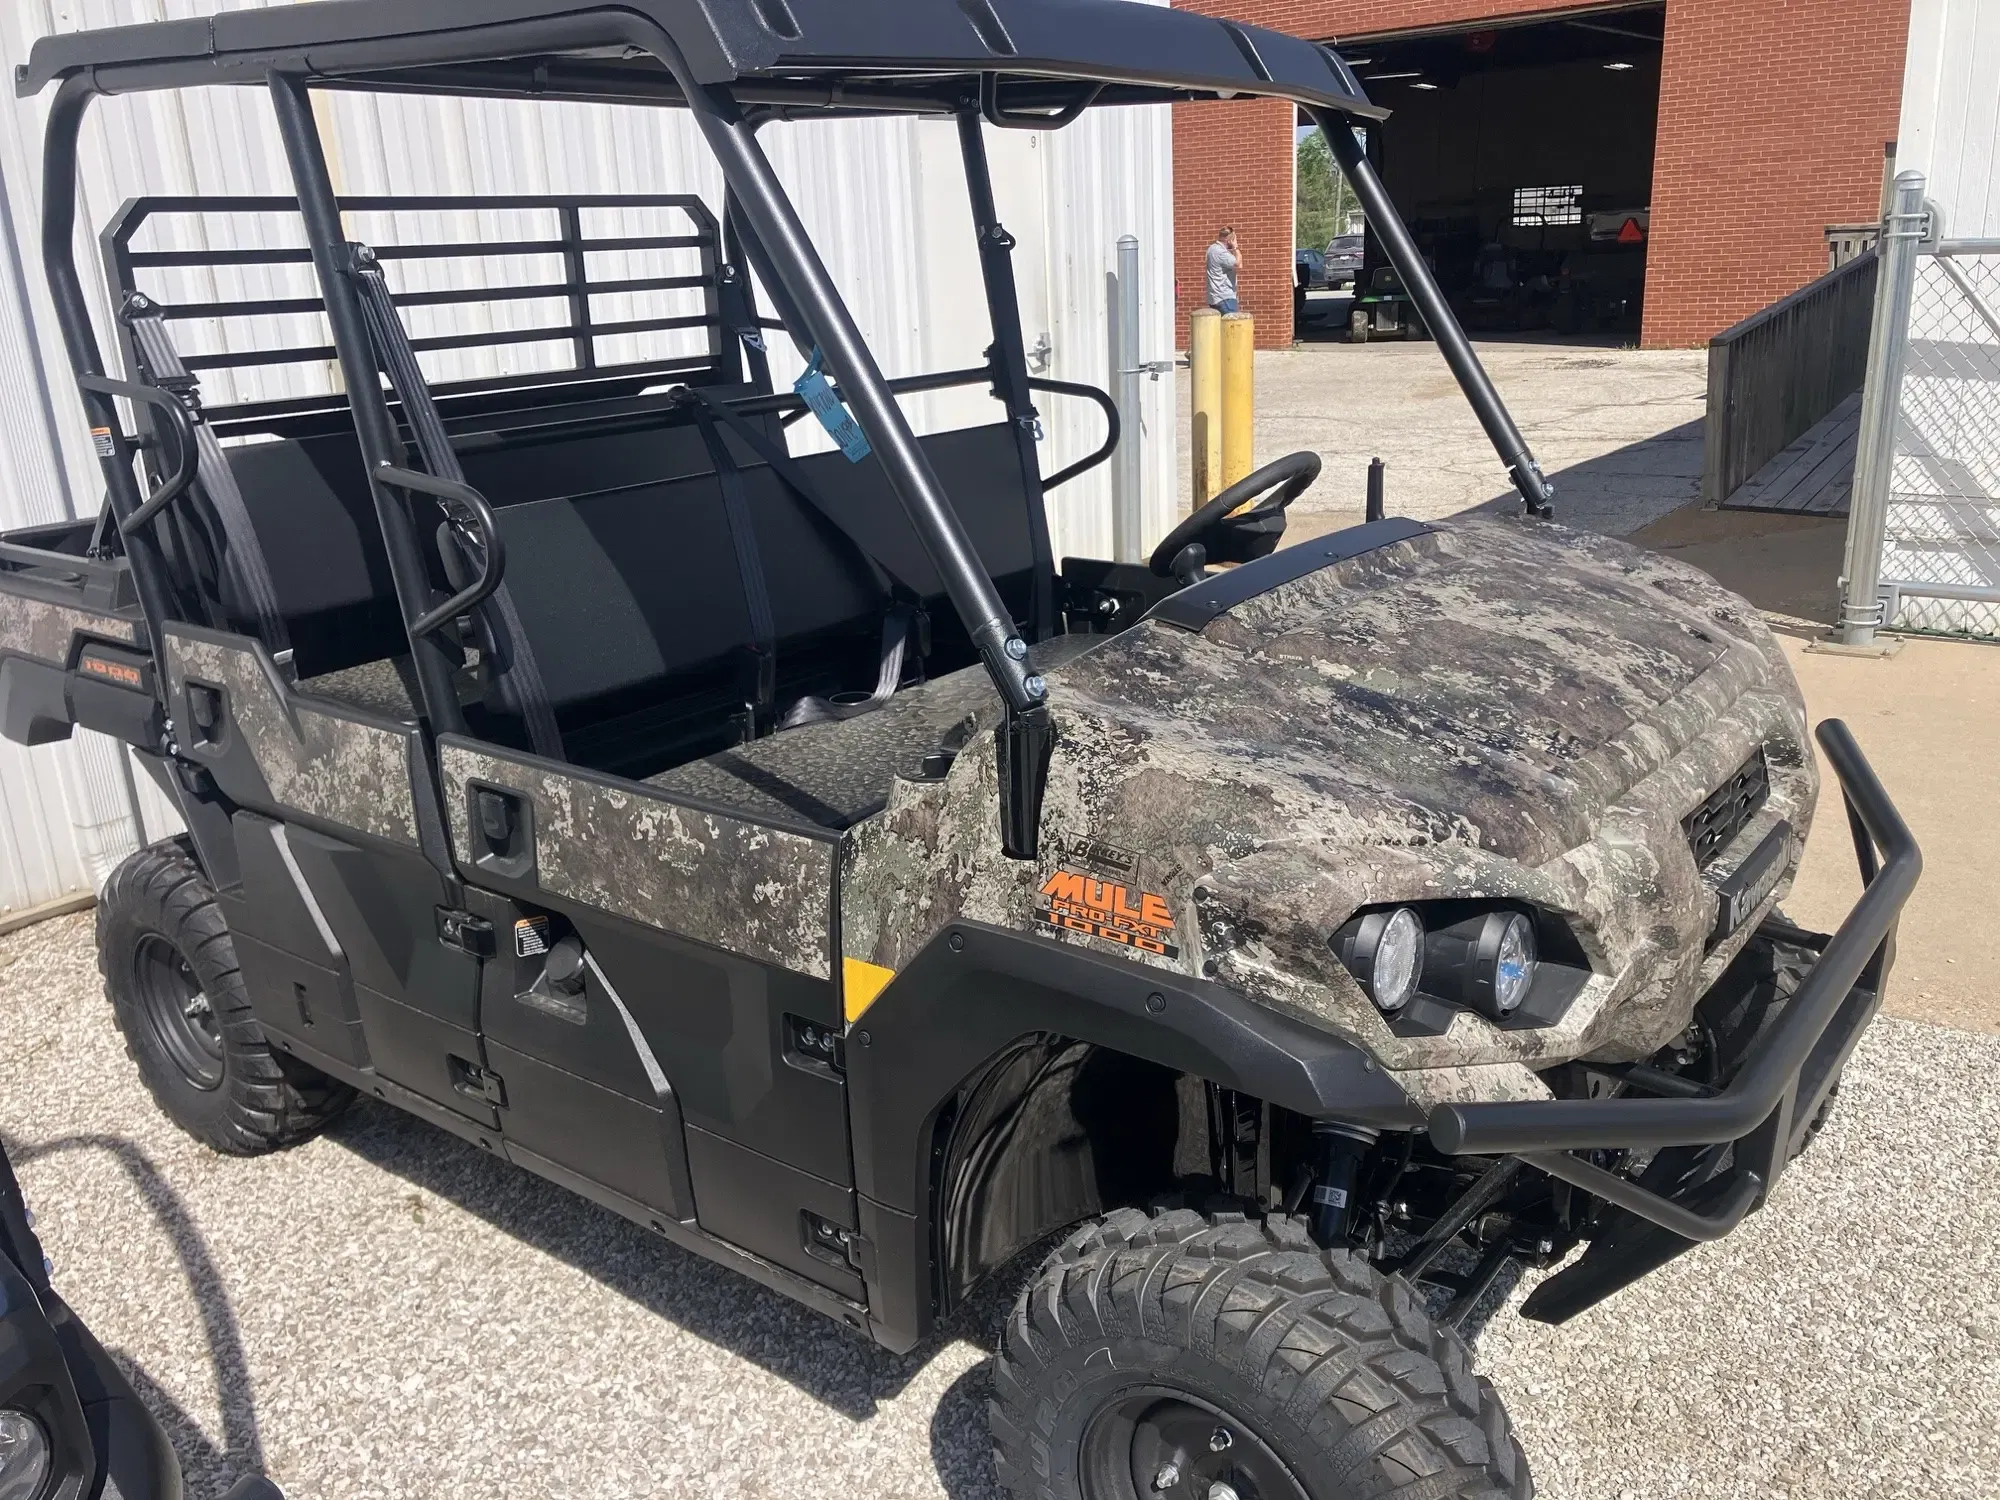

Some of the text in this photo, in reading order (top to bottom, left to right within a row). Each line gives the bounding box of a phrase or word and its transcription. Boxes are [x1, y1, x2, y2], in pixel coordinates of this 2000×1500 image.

[1030, 135, 1037, 149] 9
[1039, 870, 1176, 930] MULE
[1052, 899, 1165, 939] PRO-FXT
[1048, 912, 1165, 955] 1000
